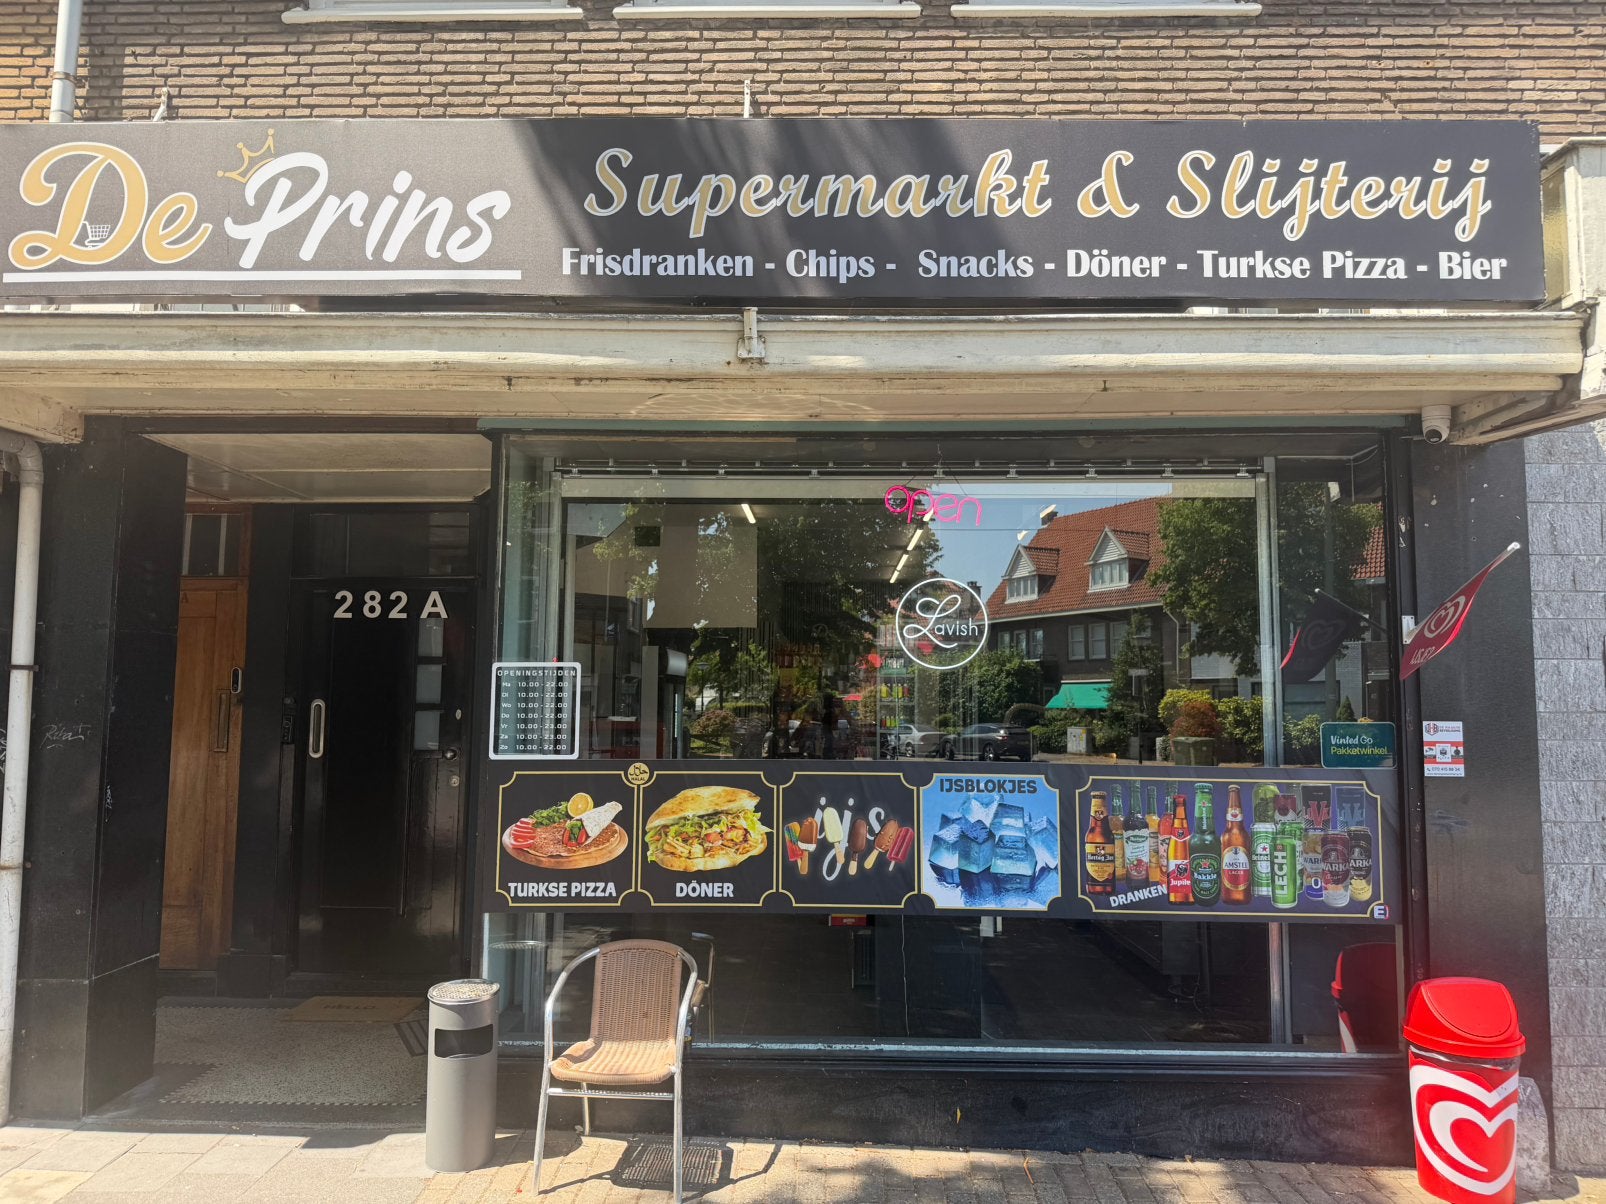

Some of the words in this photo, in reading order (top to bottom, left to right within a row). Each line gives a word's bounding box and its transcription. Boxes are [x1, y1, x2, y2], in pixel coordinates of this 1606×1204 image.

[584, 147, 1052, 239] Supermarkt
[1077, 150, 1140, 220] &
[1166, 150, 1492, 243] Slijterij
[8, 141, 213, 270] De
[224, 151, 512, 269] Prins
[561, 247, 754, 278] Frisdranken
[785, 248, 875, 284] Chips
[918, 249, 1034, 279] Snacks
[1066, 248, 1167, 279] Döner
[1197, 249, 1311, 280] Turkse
[1322, 250, 1407, 280] Pizza
[1438, 250, 1508, 281] Bier
[884, 484, 983, 527] open
[333, 590, 408, 619] 282
[420, 590, 448, 619] A
[903, 594, 978, 649] Lavish
[497, 669, 576, 677] OPENINGSTIJDEN
[1330, 735, 1359, 745] Vinted
[1359, 736, 1374, 745] Go
[1330, 745, 1388, 755] Pakketwinkel
[940, 778, 1038, 794] IJSBLOKJES
[508, 882, 567, 898] TURKSE
[571, 882, 617, 897] PIZZA
[675, 880, 734, 898] DÖNER
[1169, 879, 1191, 887] Jupile
[1110, 884, 1168, 907] DRANKEN
